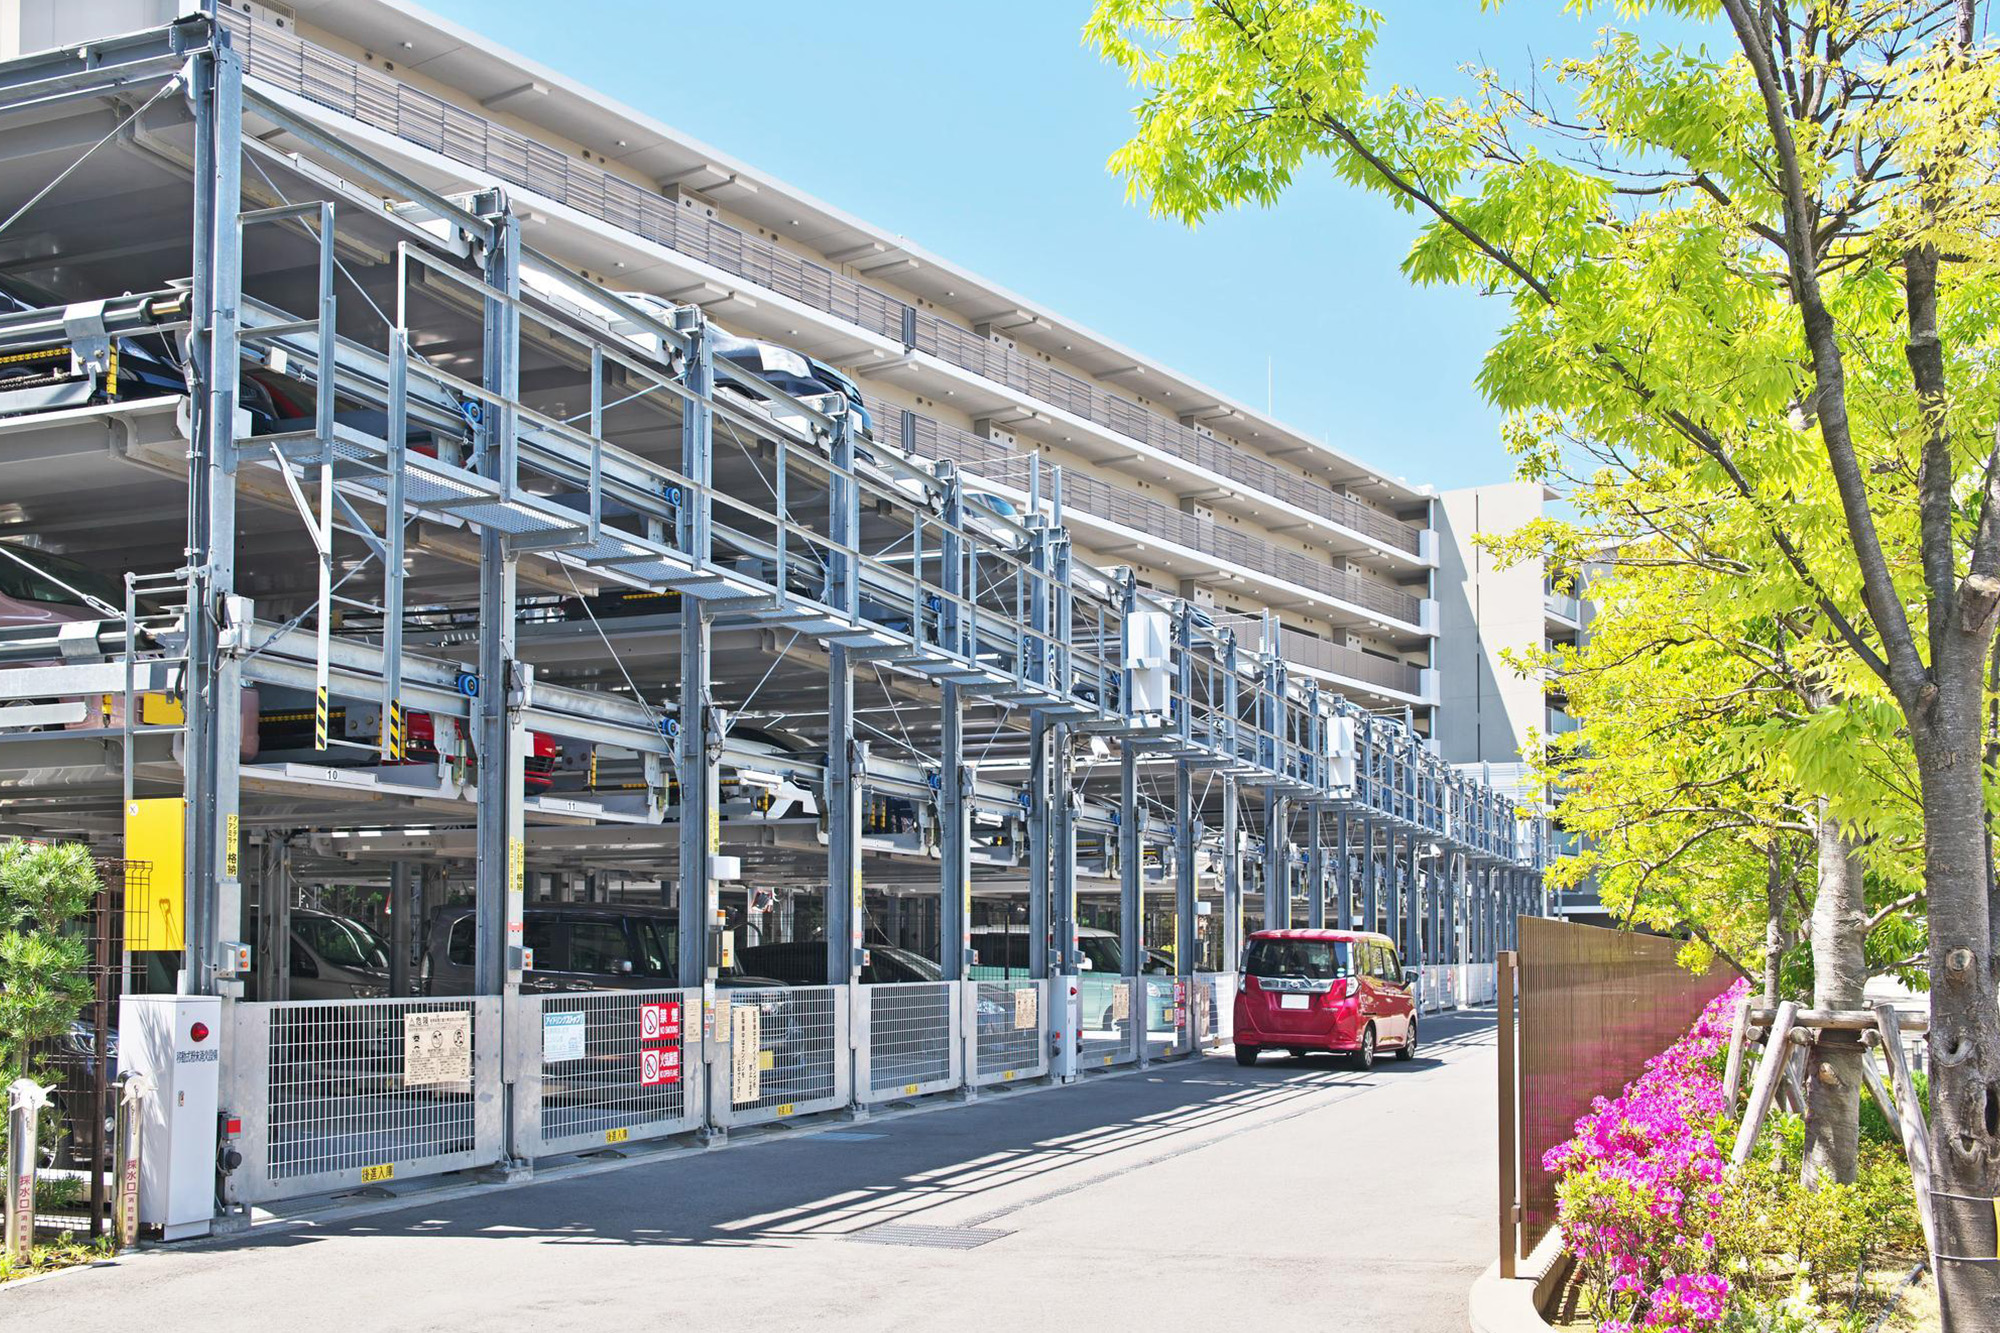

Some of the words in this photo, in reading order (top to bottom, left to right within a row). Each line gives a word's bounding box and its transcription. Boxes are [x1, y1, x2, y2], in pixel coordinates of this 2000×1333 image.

[327, 770, 338, 780] 10
[567, 802, 576, 810] 11
[126, 1159, 137, 1191] 採水口
[19, 1175, 31, 1209] 採水口
